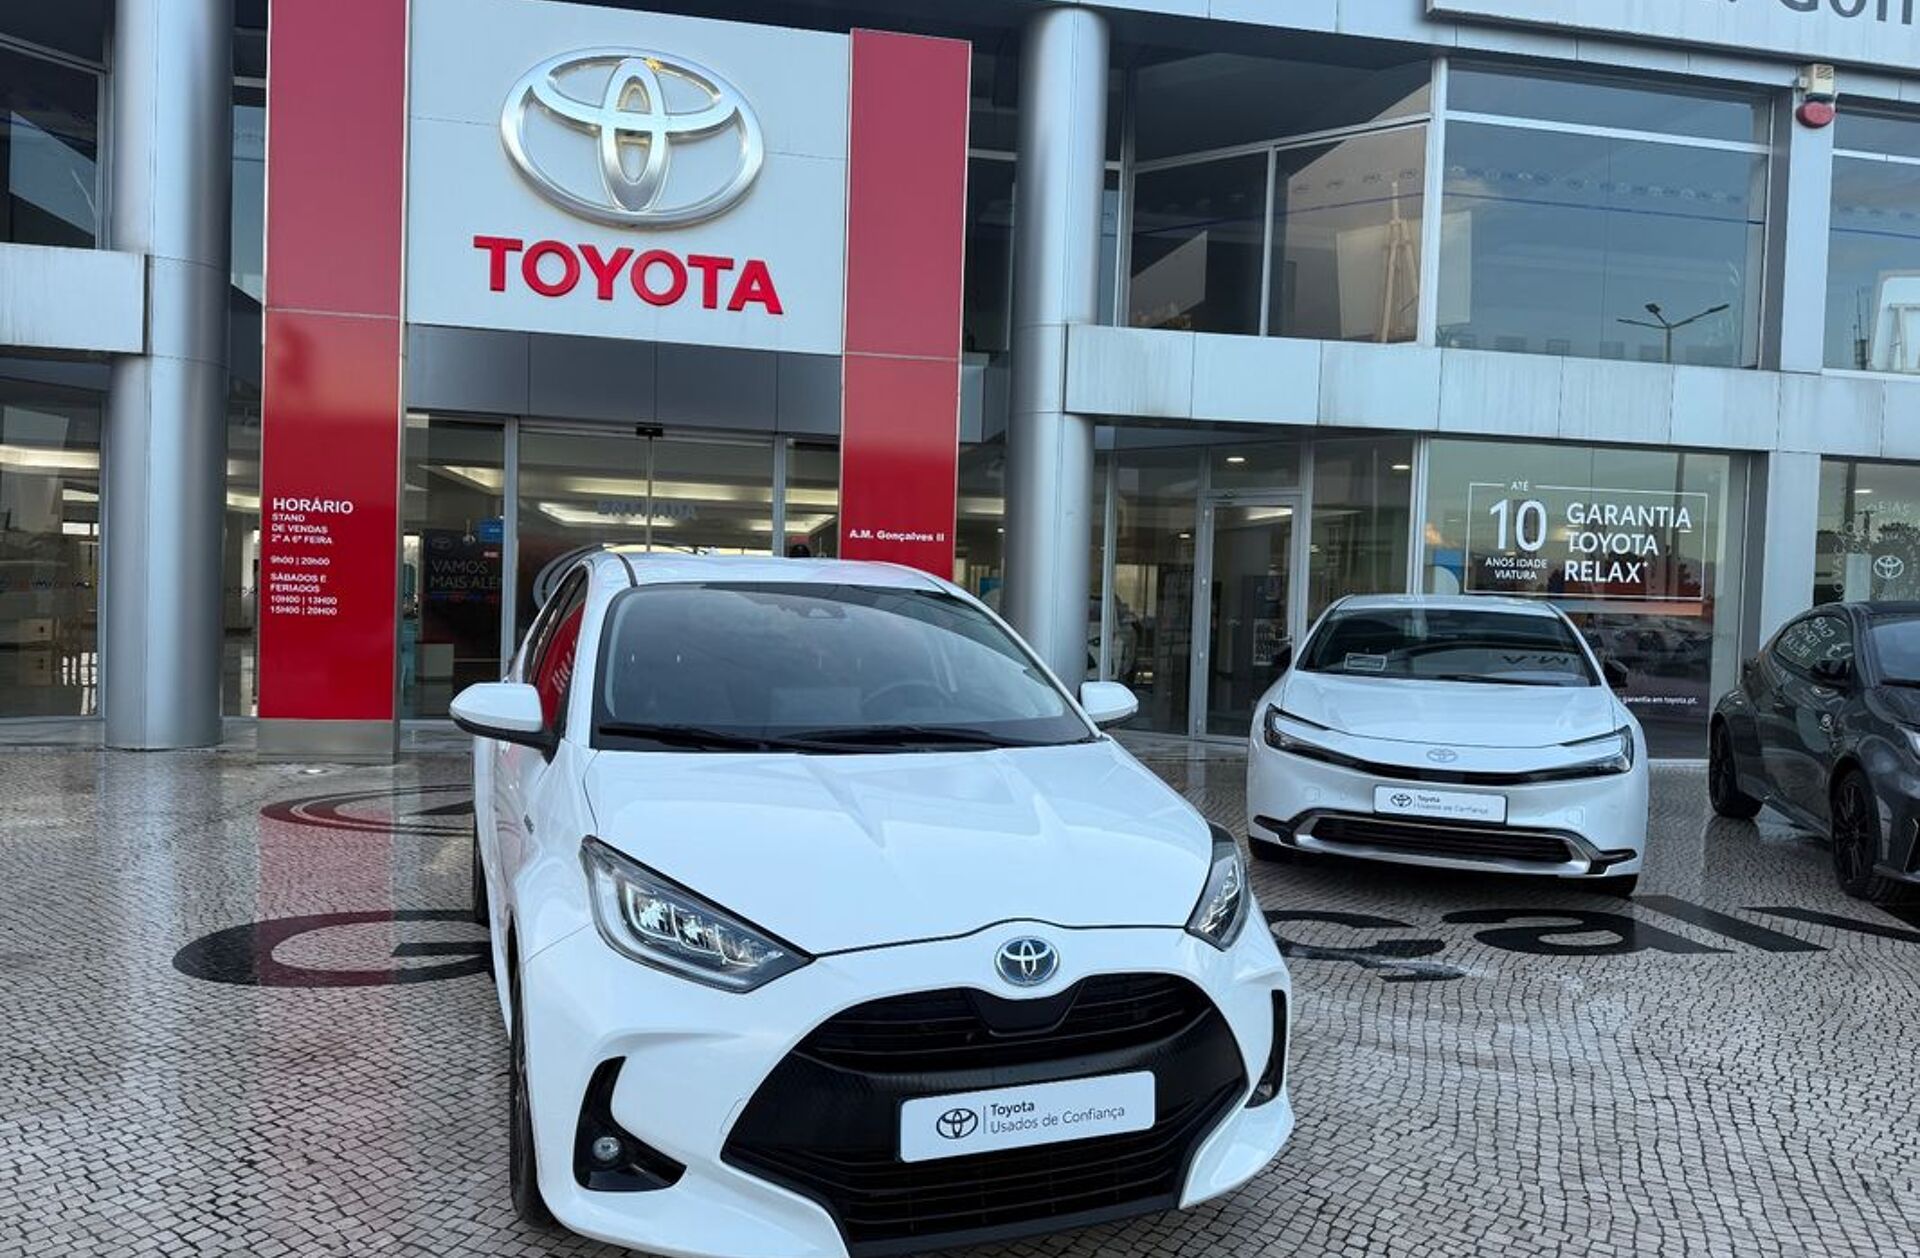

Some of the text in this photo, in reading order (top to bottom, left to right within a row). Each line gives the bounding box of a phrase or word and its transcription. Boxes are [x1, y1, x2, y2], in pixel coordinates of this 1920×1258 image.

[473, 235, 784, 315] TOYOTA
[1511, 481, 1529, 491] ATÉ
[273, 496, 354, 514] HORÁRIO
[272, 513, 305, 522] STAND
[1566, 502, 1692, 529] GARANTIA
[272, 524, 328, 534] DE VENDAS
[1490, 499, 1547, 551] 10
[304, 535, 332, 544] FEIRA
[849, 529, 874, 539] A.M.
[876, 530, 934, 543] Gonçalves
[1568, 531, 1659, 556] TOYOTA
[431, 560, 489, 575] VAMOS
[1485, 557, 1548, 569] ANOS IDADE
[270, 573, 326, 583] SÁBADOS E
[1495, 569, 1537, 580] VIATURA
[270, 583, 320, 593] FERIADOS
[431, 576, 467, 588] MAIS
[990, 1101, 1035, 1118] Toyota
[990, 1106, 1125, 1135] Usados de Confiança
